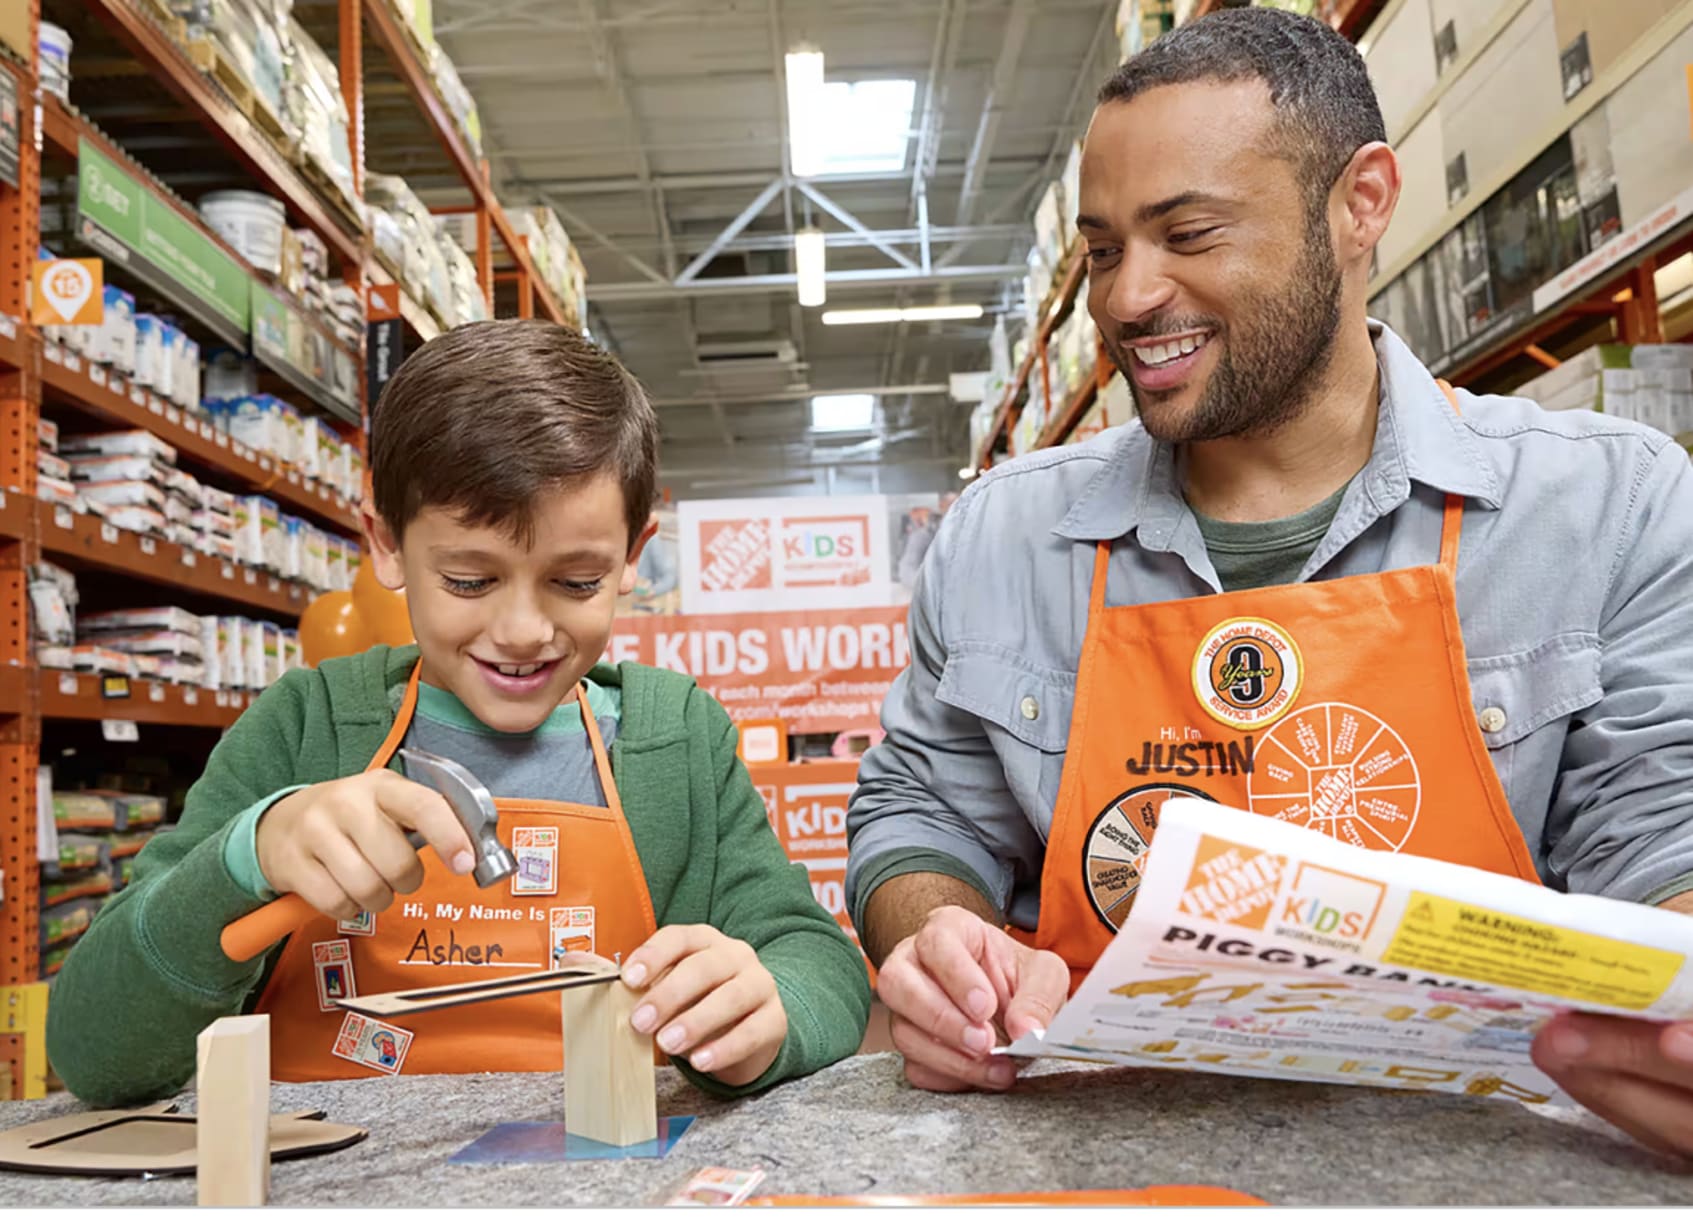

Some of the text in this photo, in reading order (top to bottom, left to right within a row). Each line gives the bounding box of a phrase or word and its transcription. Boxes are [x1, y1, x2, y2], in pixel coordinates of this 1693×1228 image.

[783, 532, 854, 560] KIDS
[655, 628, 769, 677] KIDS
[1204, 626, 1287, 658] THE HOME DEPOT
[1228, 643, 1265, 705] 9
[1209, 689, 1288, 720] SERVICE AWARD
[1160, 727, 1202, 742] Hi, I'm
[1126, 736, 1255, 777] JUSTIN
[1198, 847, 1240, 879] THE
[1182, 852, 1284, 917] HOME
[403, 903, 429, 920] Hi,
[435, 903, 463, 921] My
[469, 904, 523, 920] Name
[529, 906, 545, 921] Is
[1282, 895, 1364, 939] KIDS
[405, 928, 503, 965] Asher
[1162, 925, 1334, 969] PIGGY
[1274, 925, 1361, 955] WORKSHOPS
